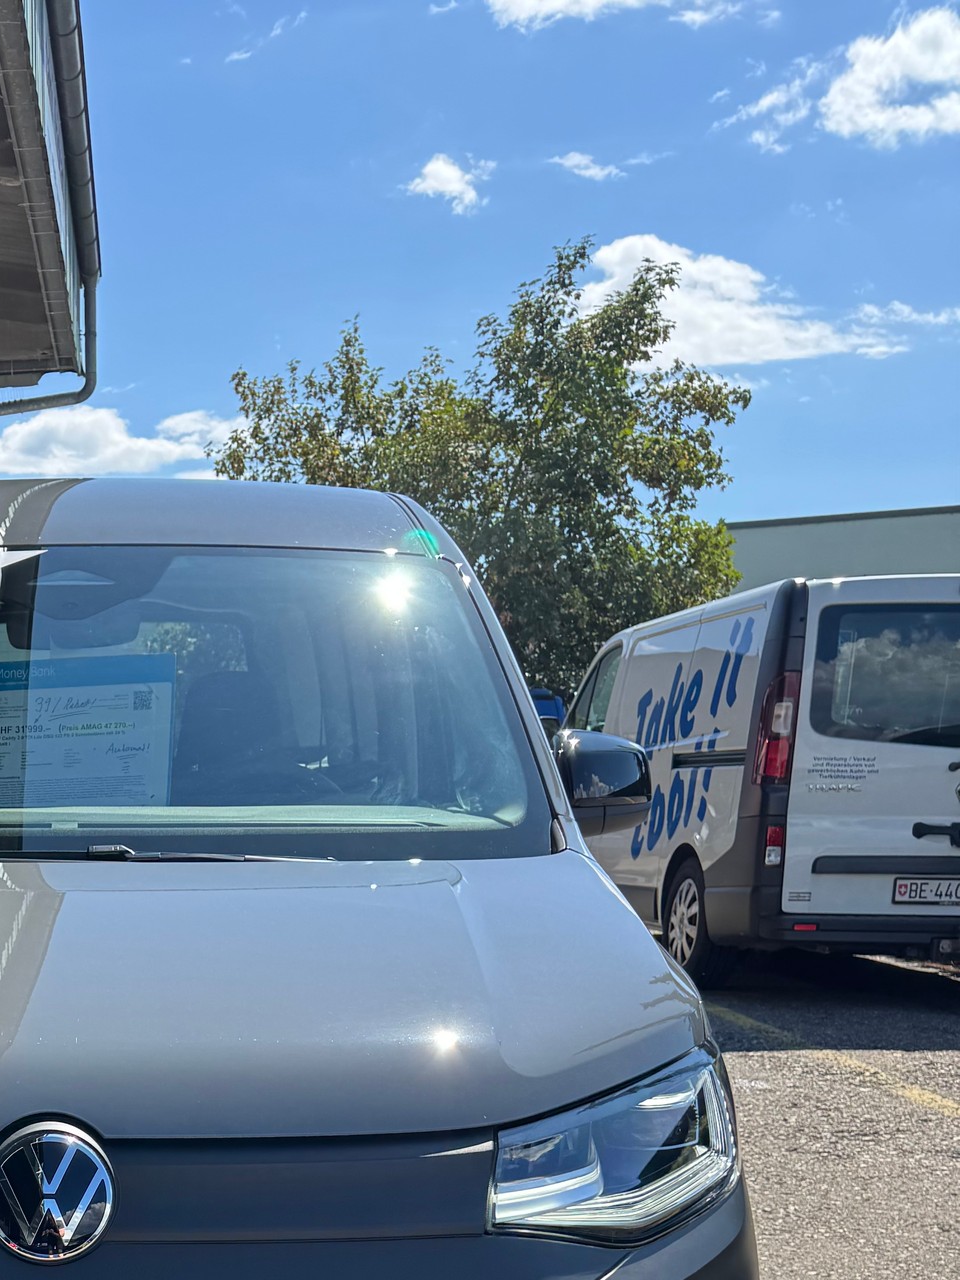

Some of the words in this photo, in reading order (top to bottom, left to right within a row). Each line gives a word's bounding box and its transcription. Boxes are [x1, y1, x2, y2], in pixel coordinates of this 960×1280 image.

[31, 666, 56, 677] Bank
[635, 662, 704, 761] Take
[710, 616, 755, 718] it
[81, 722, 103, 731] AMAG
[103, 721, 113, 730] 47
[805, 783, 862, 793] TRAFIC
